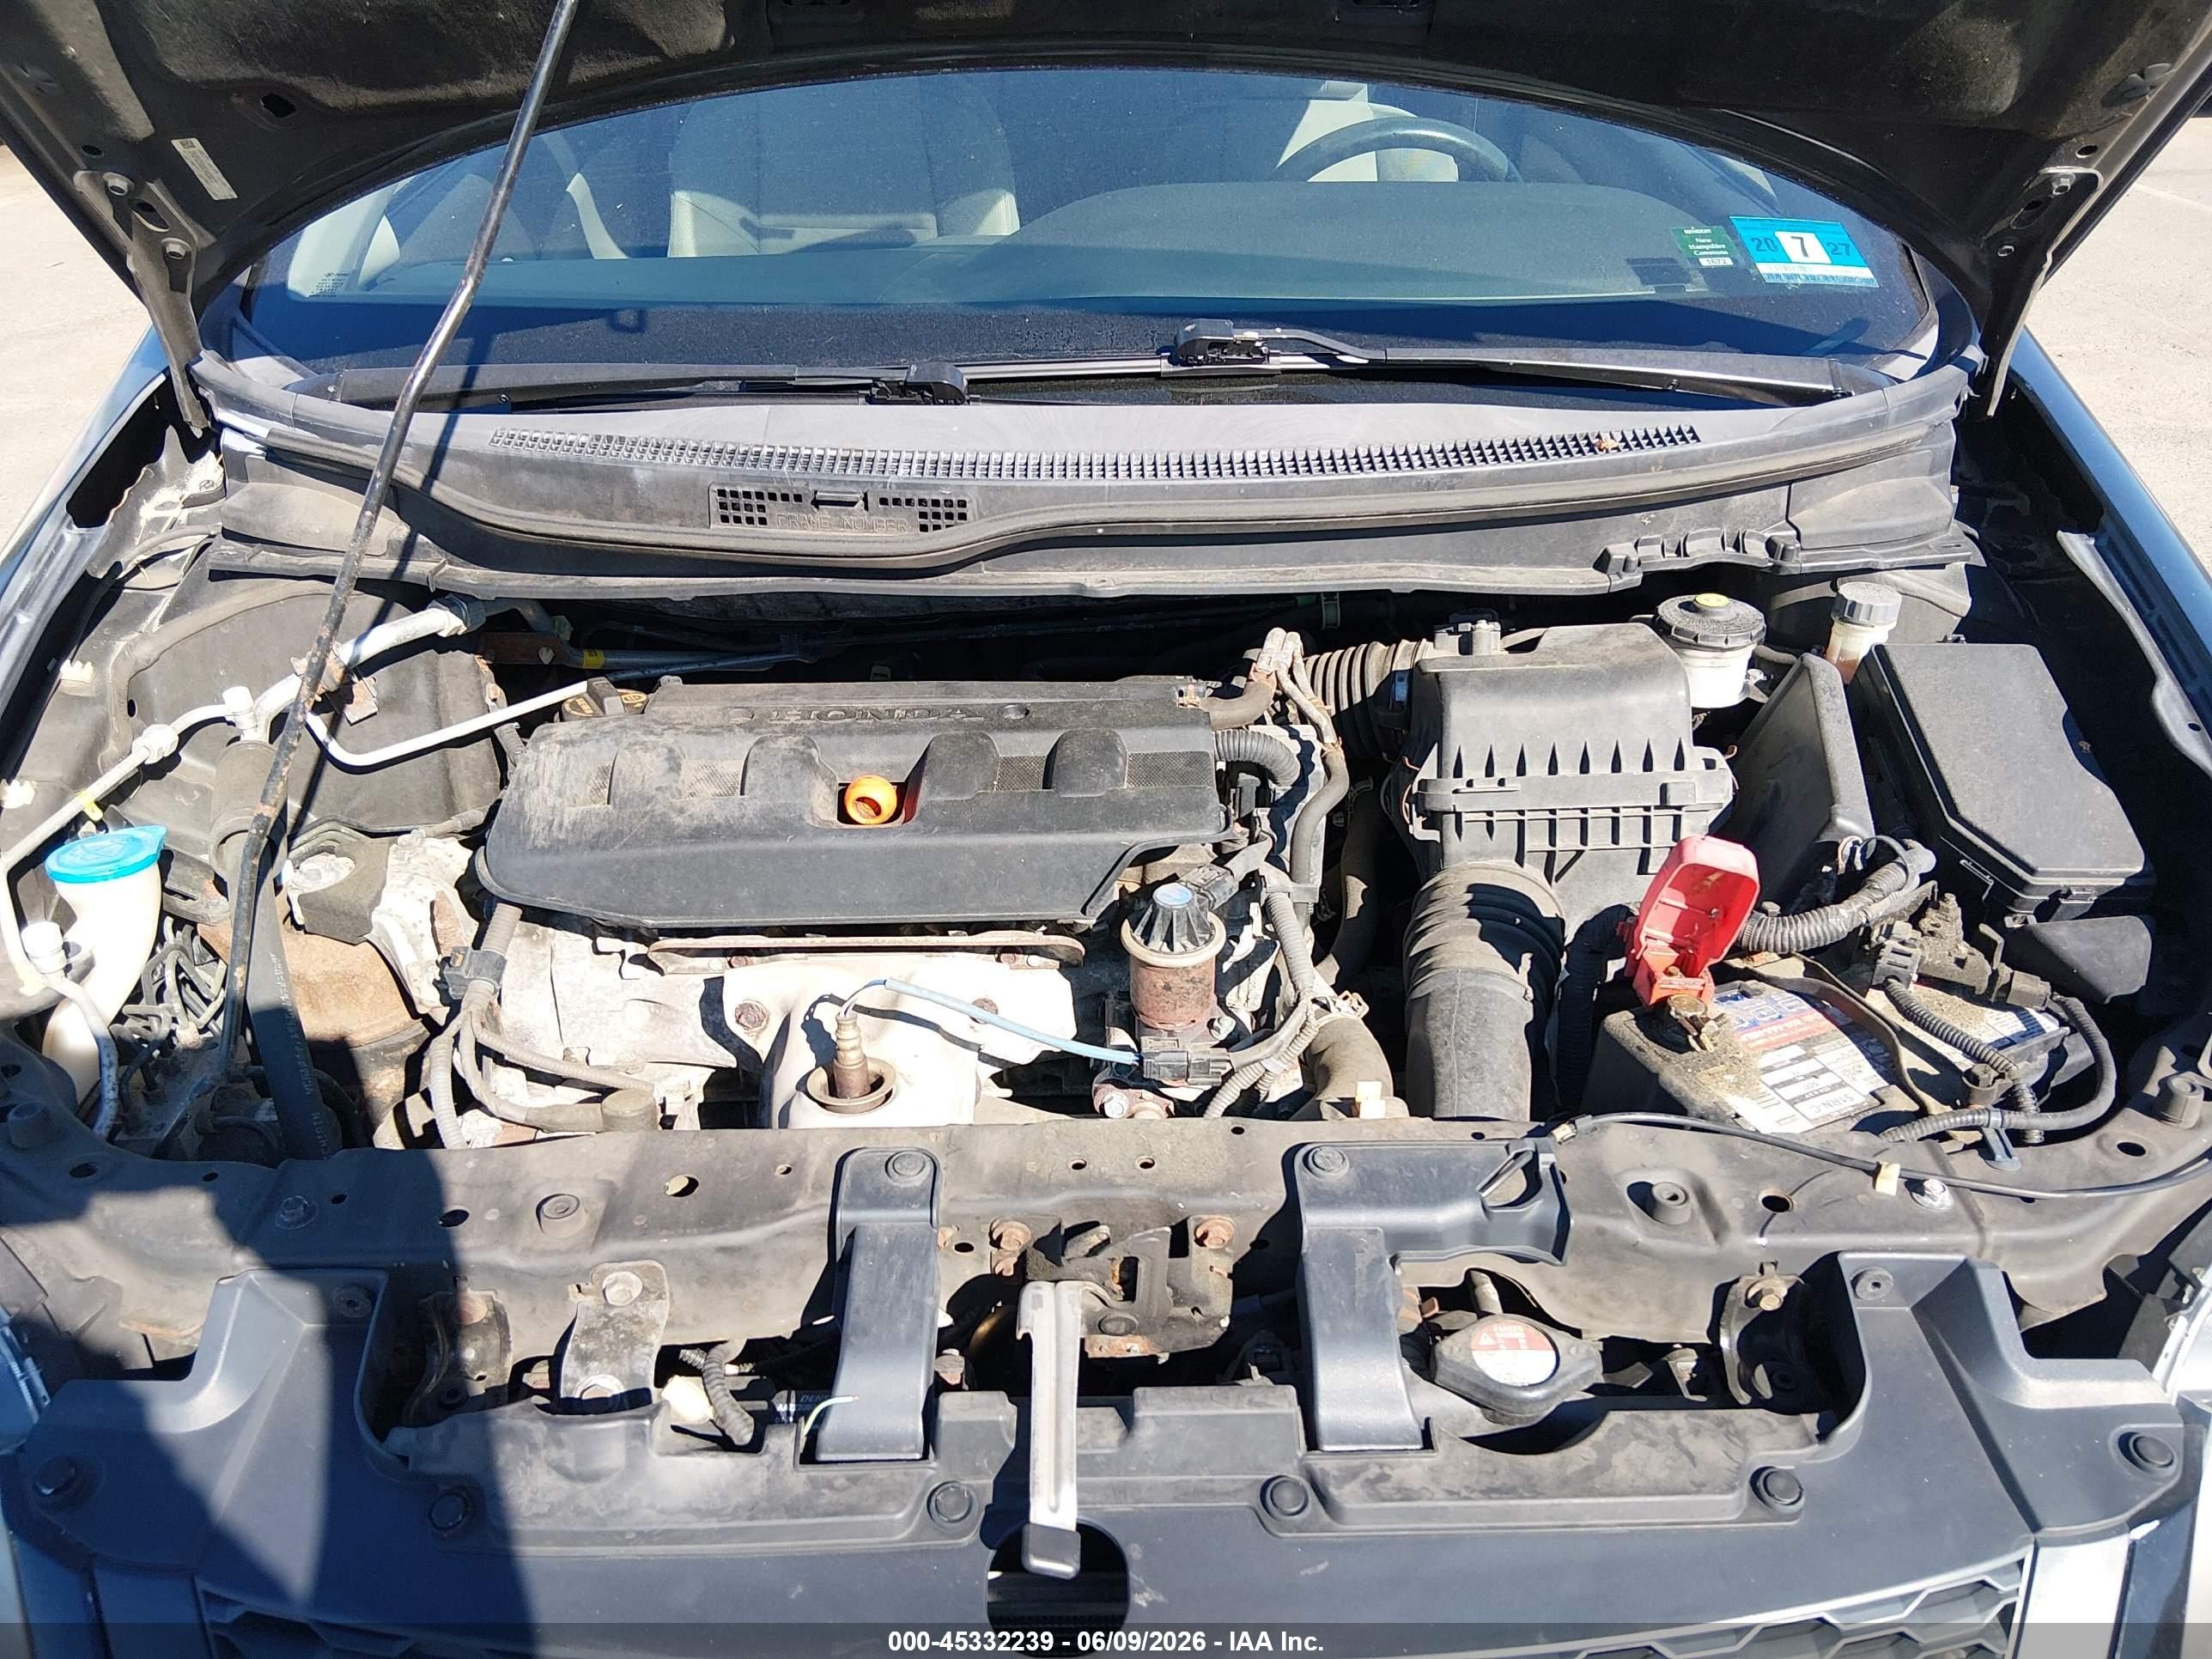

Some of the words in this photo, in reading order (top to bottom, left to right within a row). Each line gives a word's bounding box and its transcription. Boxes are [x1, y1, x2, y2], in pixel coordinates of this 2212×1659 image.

[1750, 236, 1778, 252] 20
[1790, 235, 1808, 258] 7
[1826, 241, 1850, 256] 27
[776, 513, 830, 530] FRAME
[842, 515, 908, 534] NUMBER
[769, 707, 984, 724] HONDA
